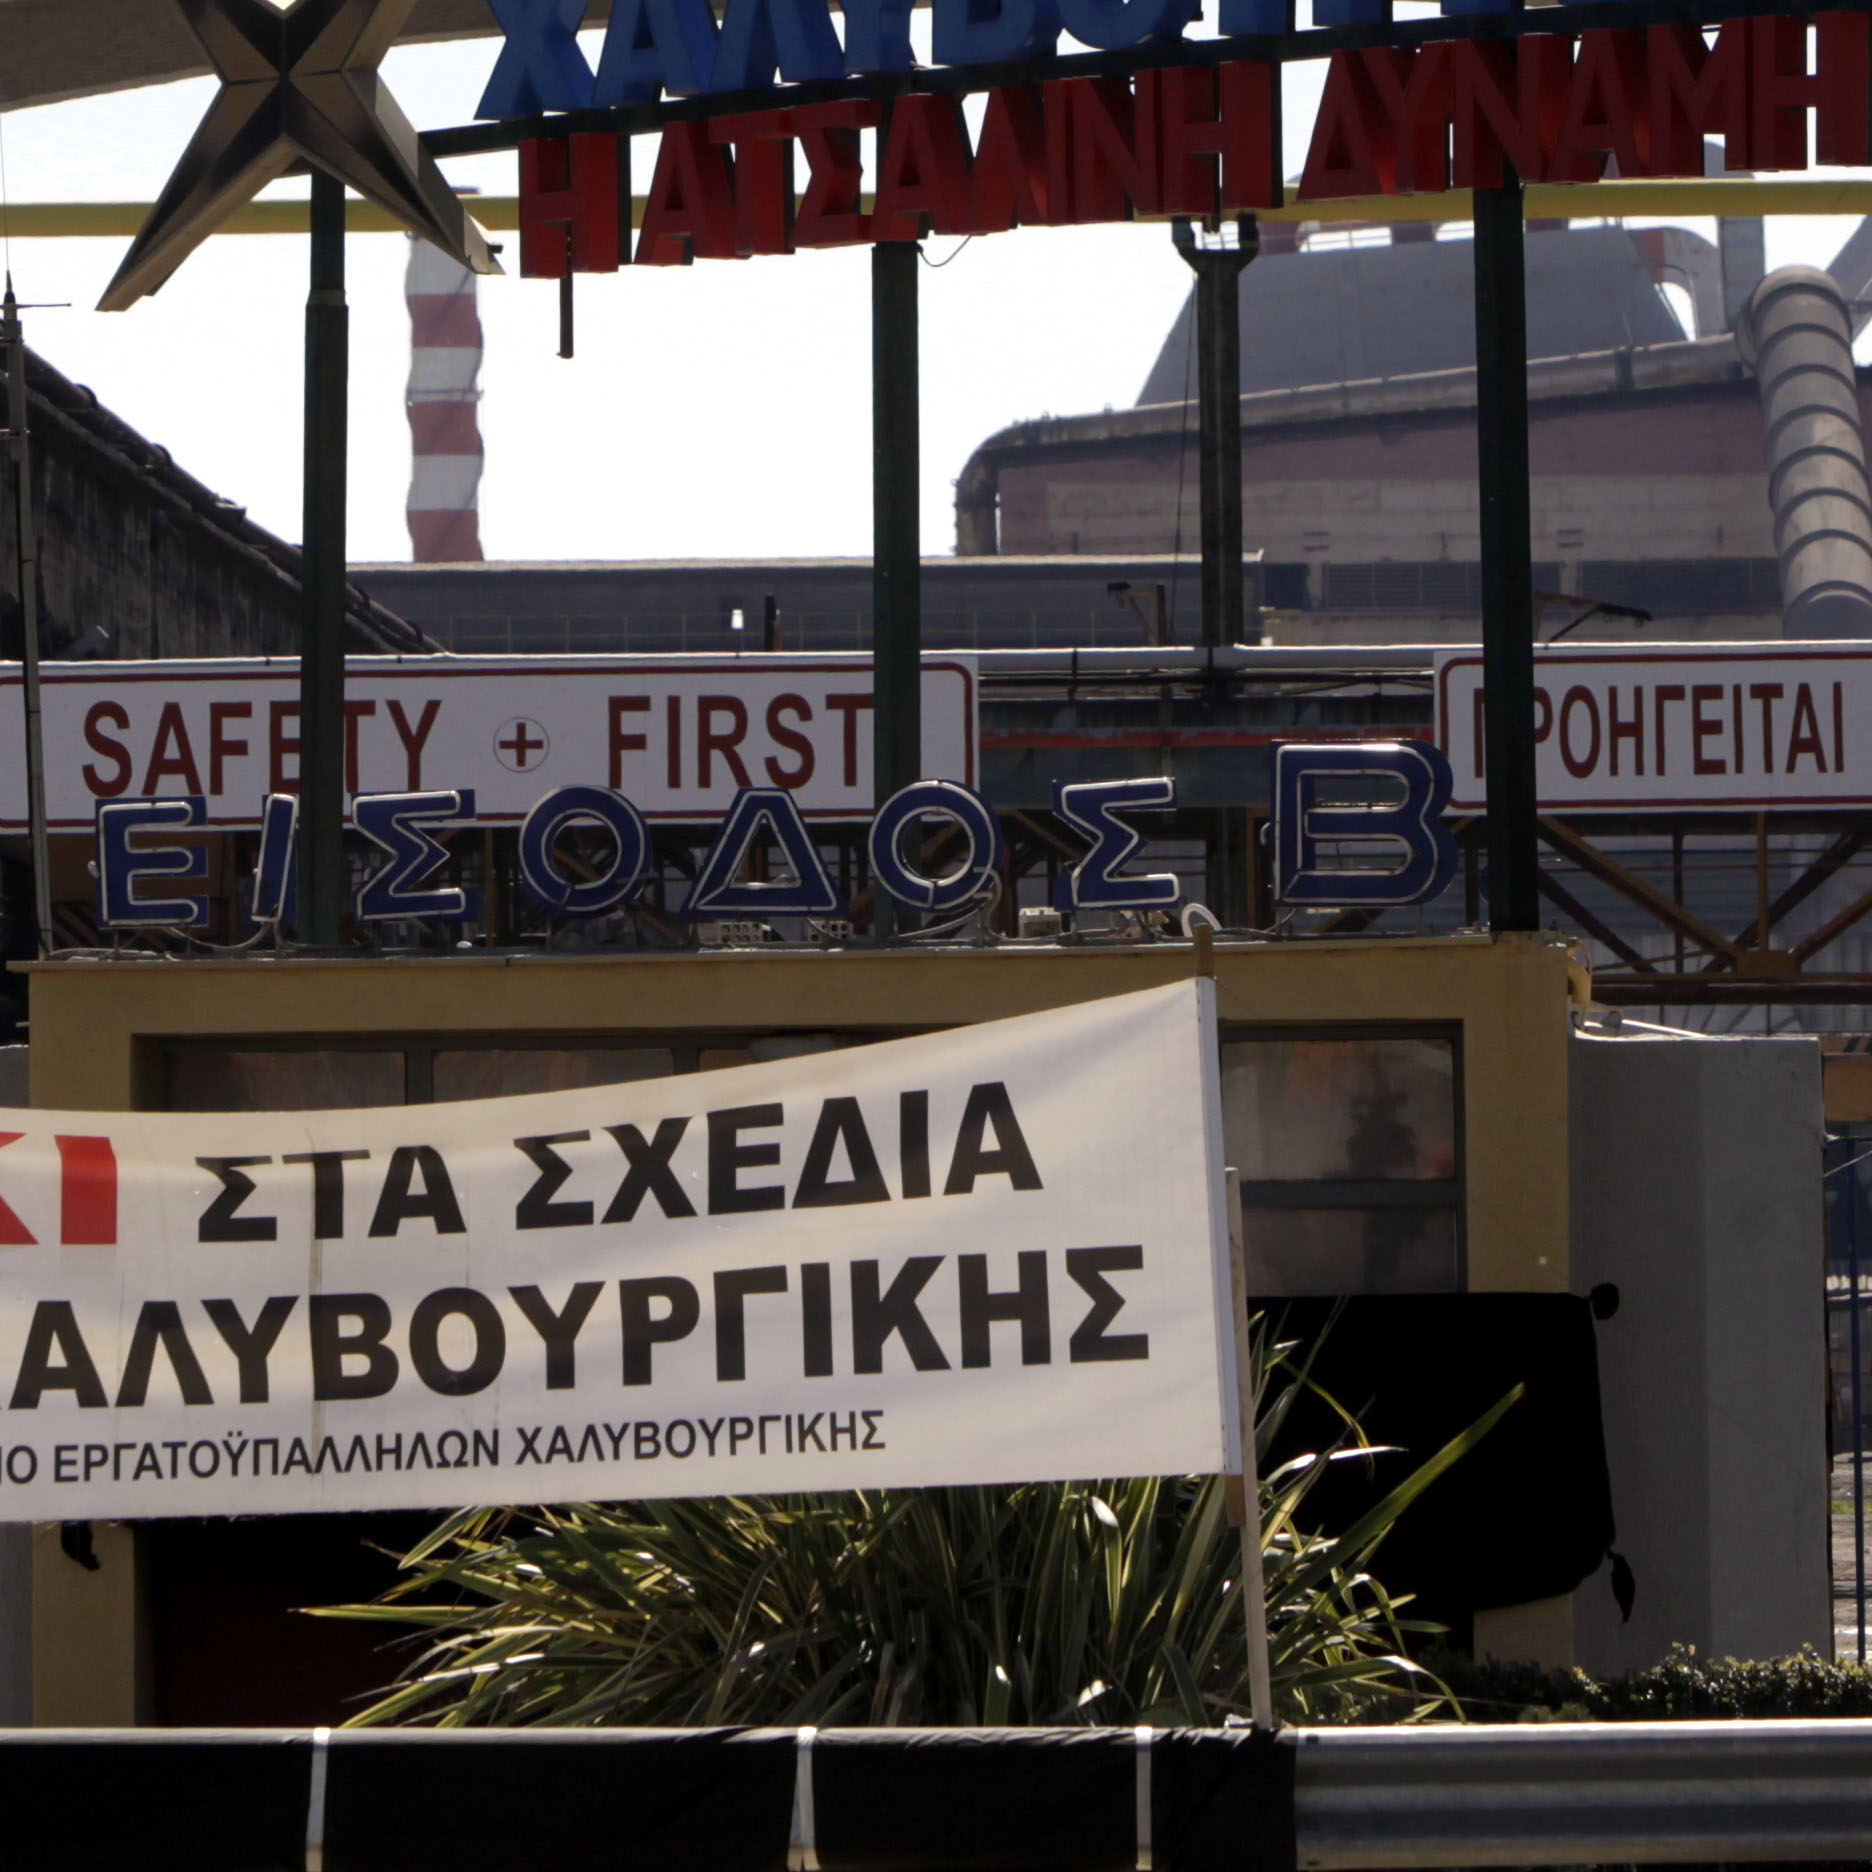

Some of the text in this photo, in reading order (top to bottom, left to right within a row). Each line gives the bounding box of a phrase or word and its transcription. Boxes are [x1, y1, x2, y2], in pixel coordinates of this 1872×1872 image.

[81, 692, 875, 797] SAFETY FIRST
[94, 776, 1178, 928] ΕΙΣΟΔΟΣ
[196, 1144, 467, 1243] ΣΤΑ
[514, 1081, 1045, 1230] ΣΧΕΔΙΑ
[516, 1410, 885, 1465] ΧΑΛΥΒΟΥΡΓΙΚΗΣ
